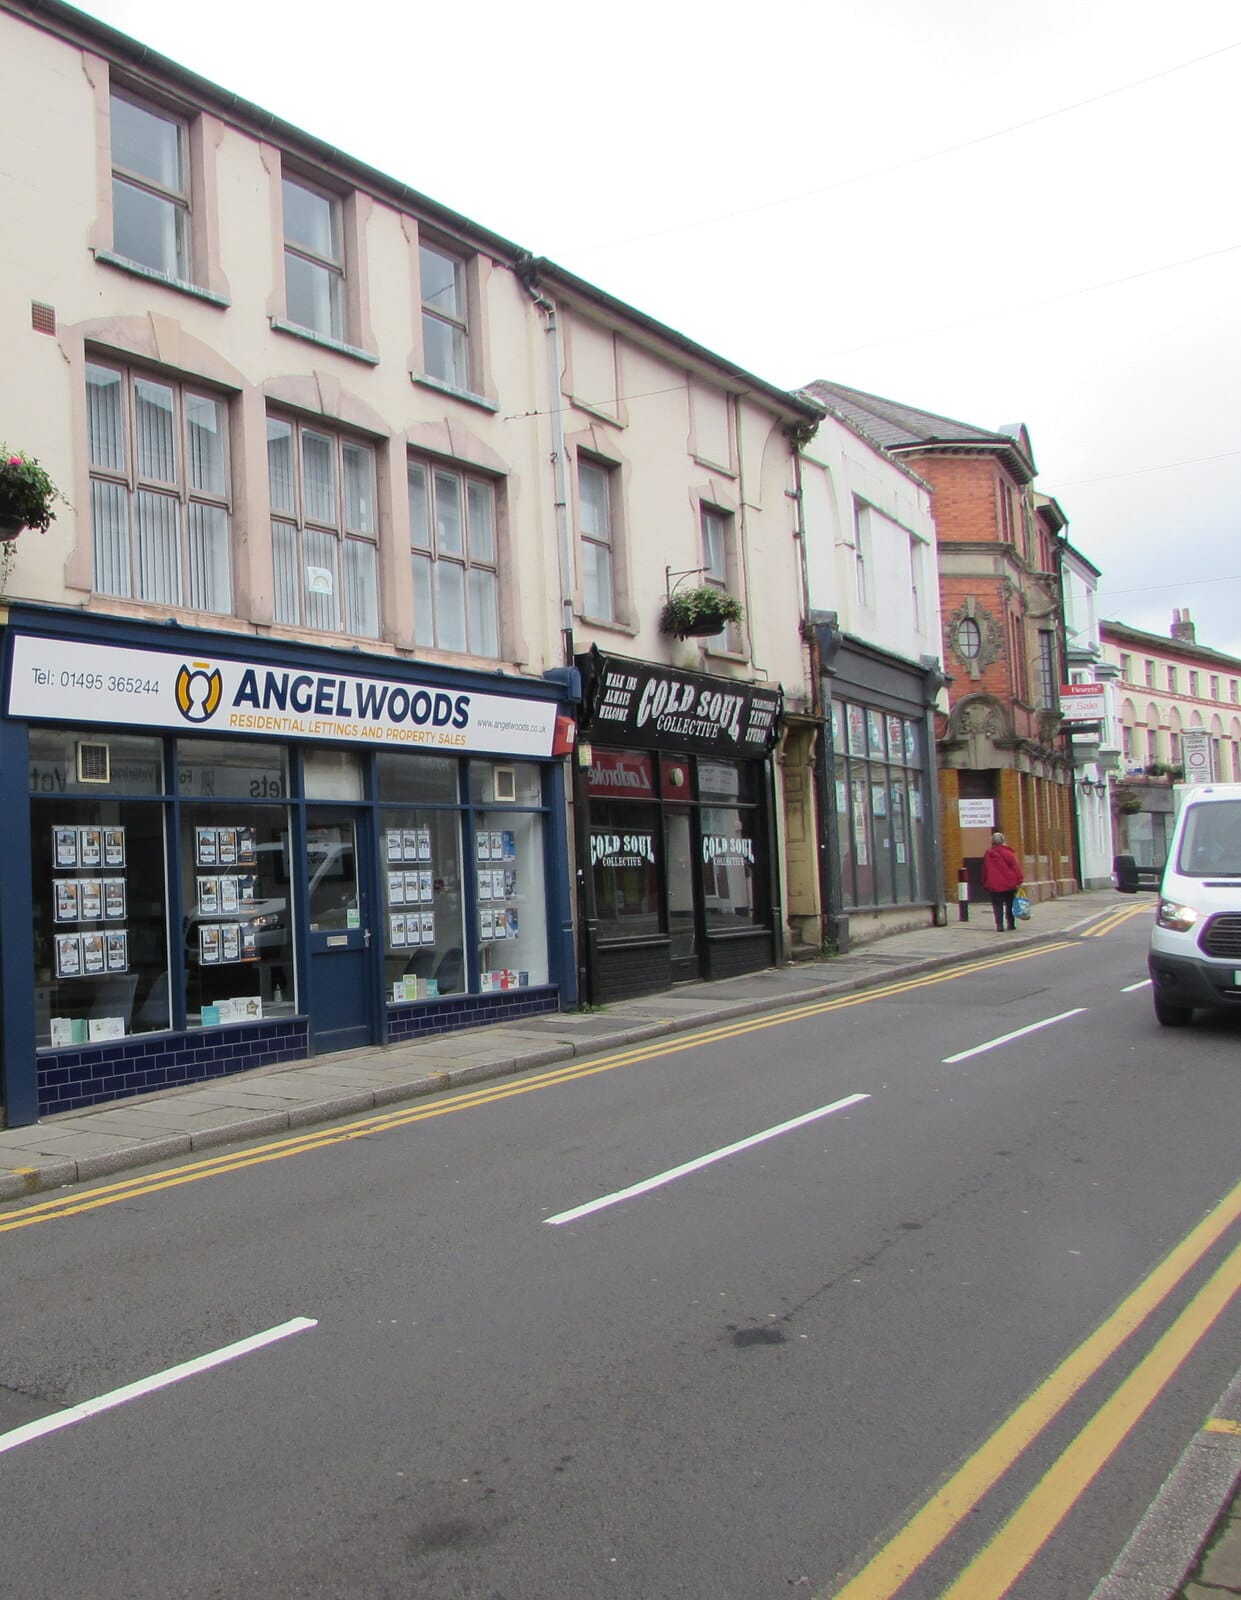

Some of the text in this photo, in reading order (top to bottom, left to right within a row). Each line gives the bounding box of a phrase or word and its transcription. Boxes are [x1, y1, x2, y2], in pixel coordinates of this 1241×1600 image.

[31, 667, 160, 695] Tel: 01495 365244
[605, 672, 638, 691] WALK INS
[232, 668, 471, 730] ANGELWOODS
[604, 689, 632, 706] ALWAYS
[1077, 701, 1098, 711] Sale
[599, 704, 629, 722] WELCOME
[636, 677, 745, 743] COLD SOUL
[229, 713, 467, 746] RESIDENTIAL LETTINGS AND PROPERTY SALES
[476, 718, 547, 735] www.angelwoods.co.uk
[656, 714, 721, 739] COLLECTIVE
[590, 834, 655, 866] COLD SOUL
[703, 836, 755, 865] COLD SOUL
[712, 856, 745, 866] COLLECTIVE
[602, 856, 642, 867] COLLECTIVE
